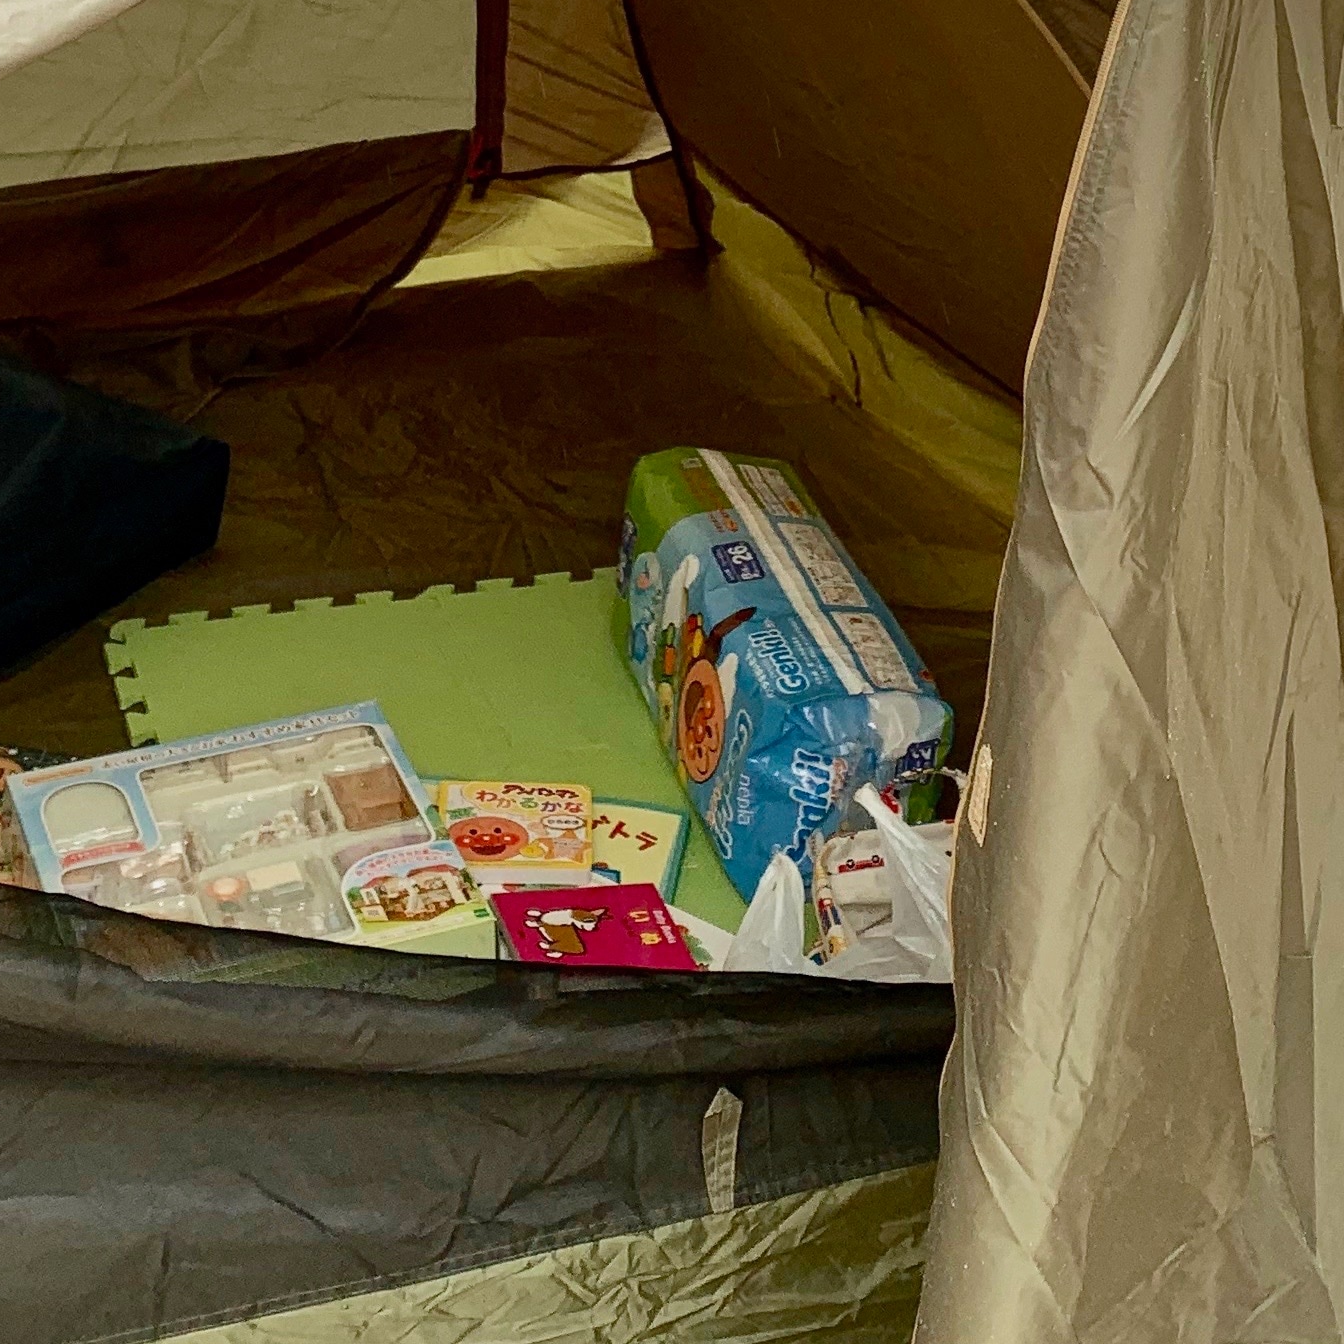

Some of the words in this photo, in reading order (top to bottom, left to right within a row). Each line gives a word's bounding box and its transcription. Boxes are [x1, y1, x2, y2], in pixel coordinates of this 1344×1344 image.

[748, 629, 810, 694] Genki!
[475, 788, 585, 814] わかるかな
